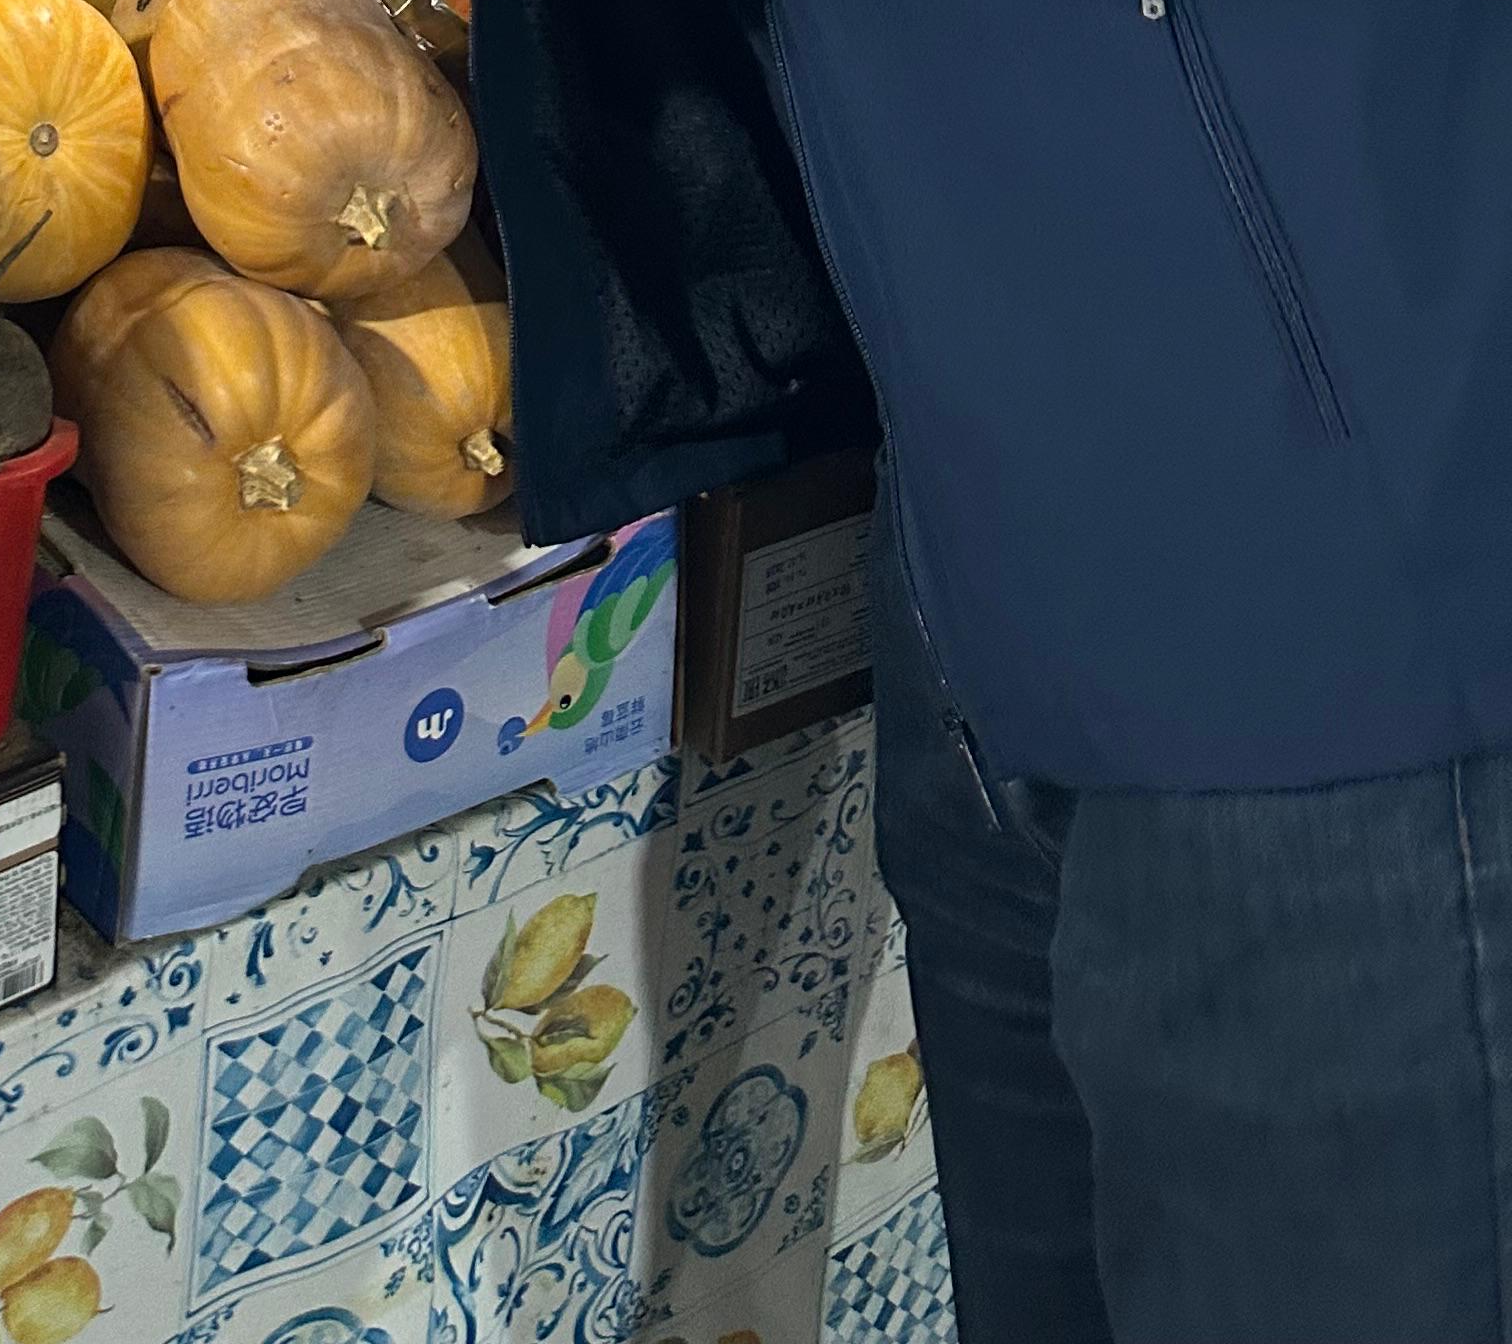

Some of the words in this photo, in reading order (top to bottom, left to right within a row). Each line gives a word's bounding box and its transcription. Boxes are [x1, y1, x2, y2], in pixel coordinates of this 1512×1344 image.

[186, 757, 310, 806] Moriberri
[184, 784, 309, 840] 早安物语
